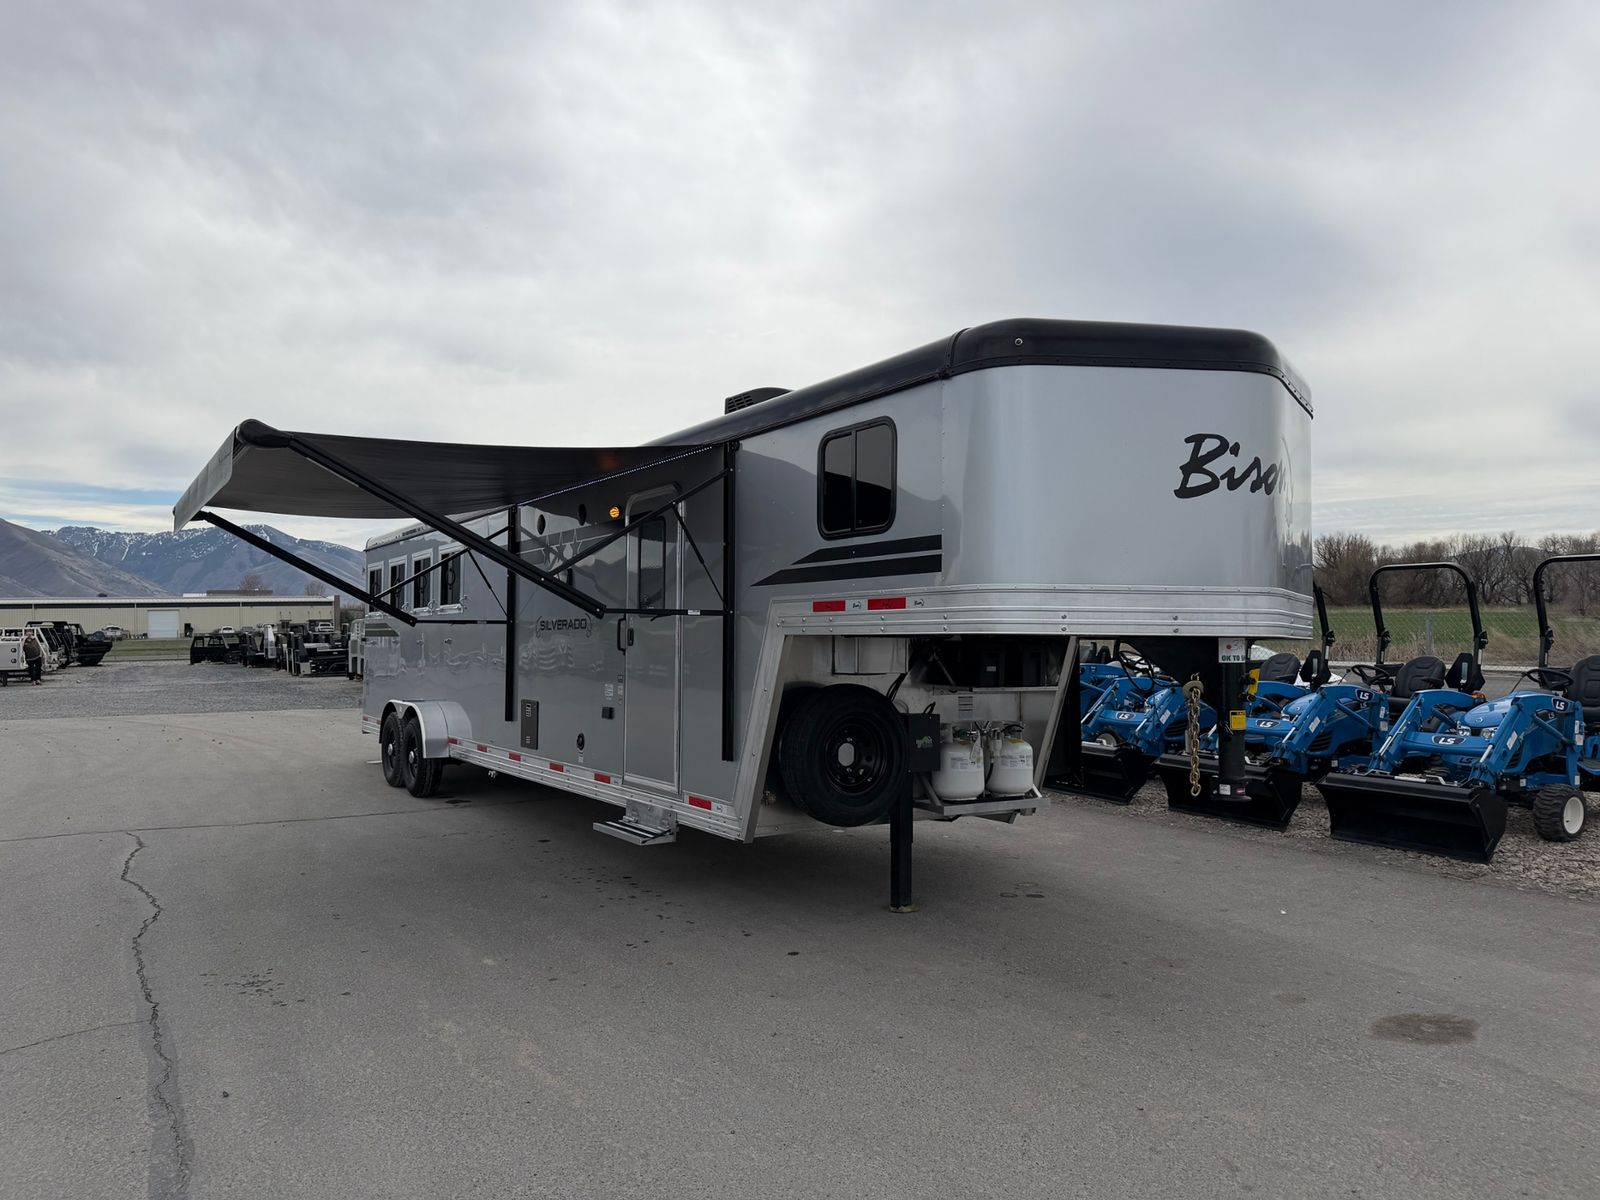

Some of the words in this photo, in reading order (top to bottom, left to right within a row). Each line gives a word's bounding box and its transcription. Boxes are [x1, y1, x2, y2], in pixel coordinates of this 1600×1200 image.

[540, 618, 587, 631] SILVERADO
[1360, 691, 1370, 700] LS
[1555, 700, 1565, 710] LS
[1438, 737, 1456, 745] LS
